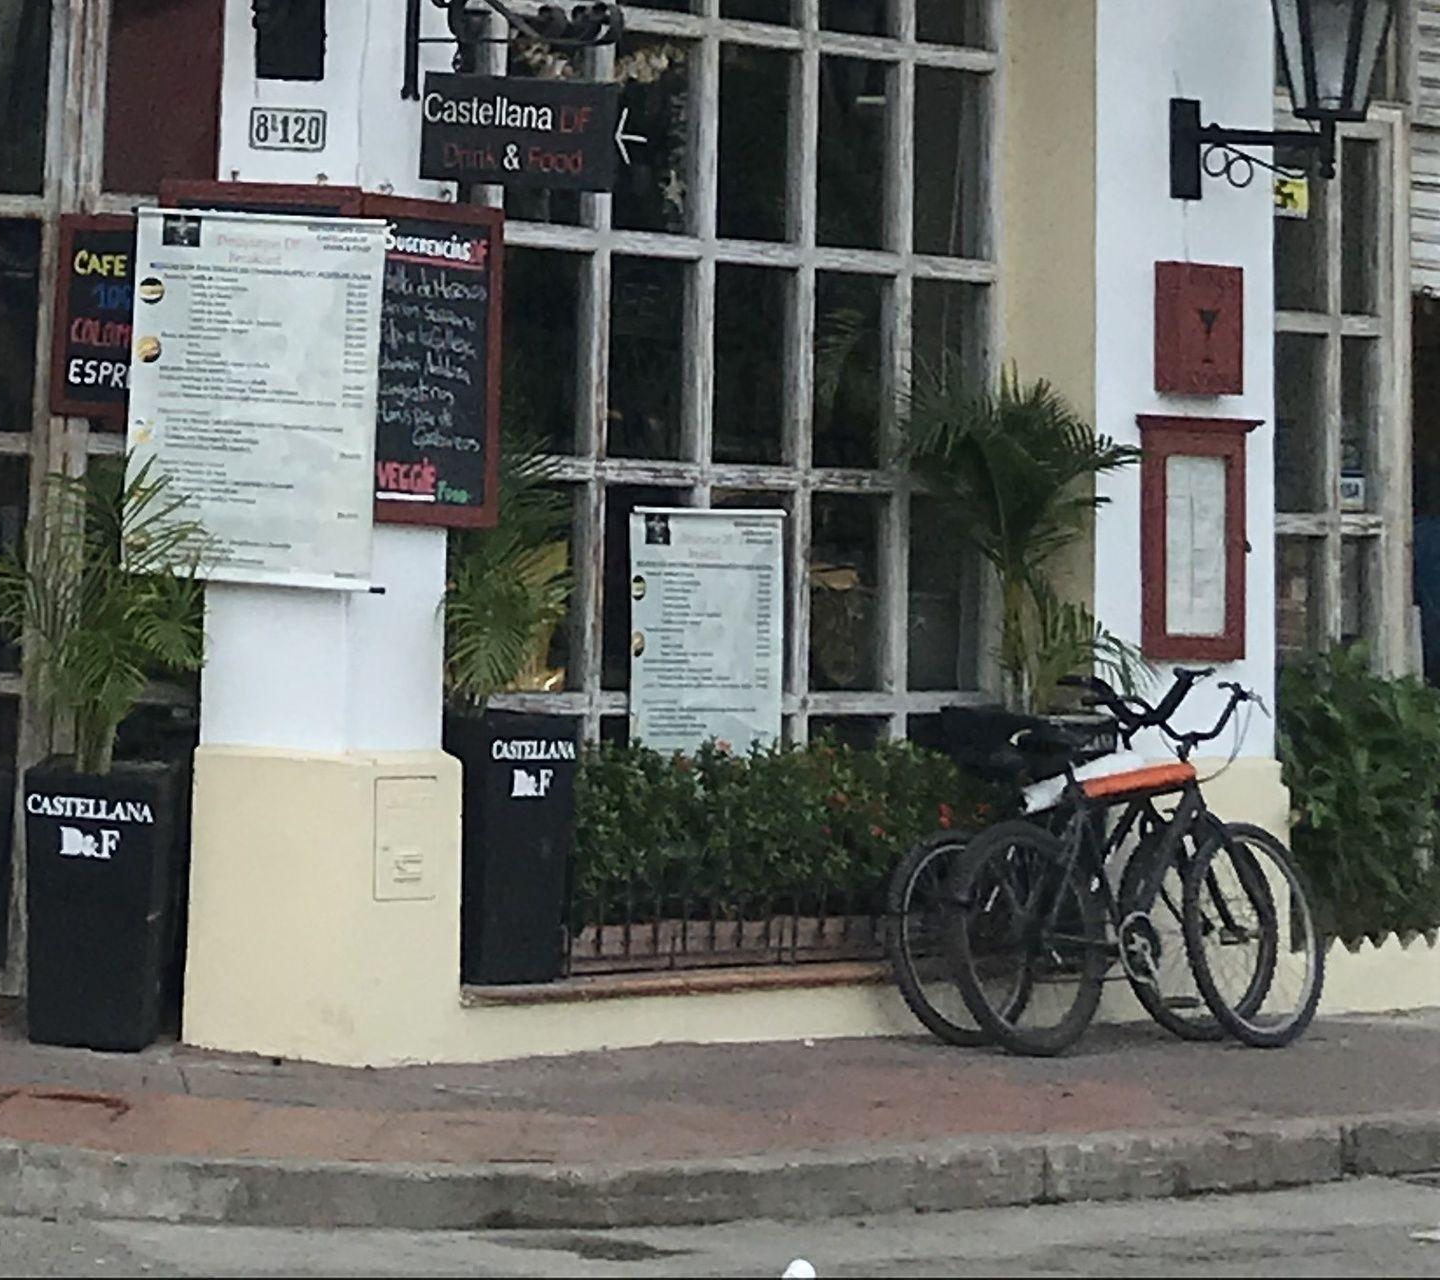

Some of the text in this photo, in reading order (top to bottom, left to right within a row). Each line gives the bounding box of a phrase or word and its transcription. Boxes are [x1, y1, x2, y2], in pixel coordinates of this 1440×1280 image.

[424, 92, 593, 133] Castellana DF
[442, 142, 584, 173] Drink & Food
[74, 250, 128, 277] CAFE
[68, 358, 131, 389] ESPR
[492, 739, 576, 760] CASTELLANA
[26, 793, 154, 823] CASTELLANA
